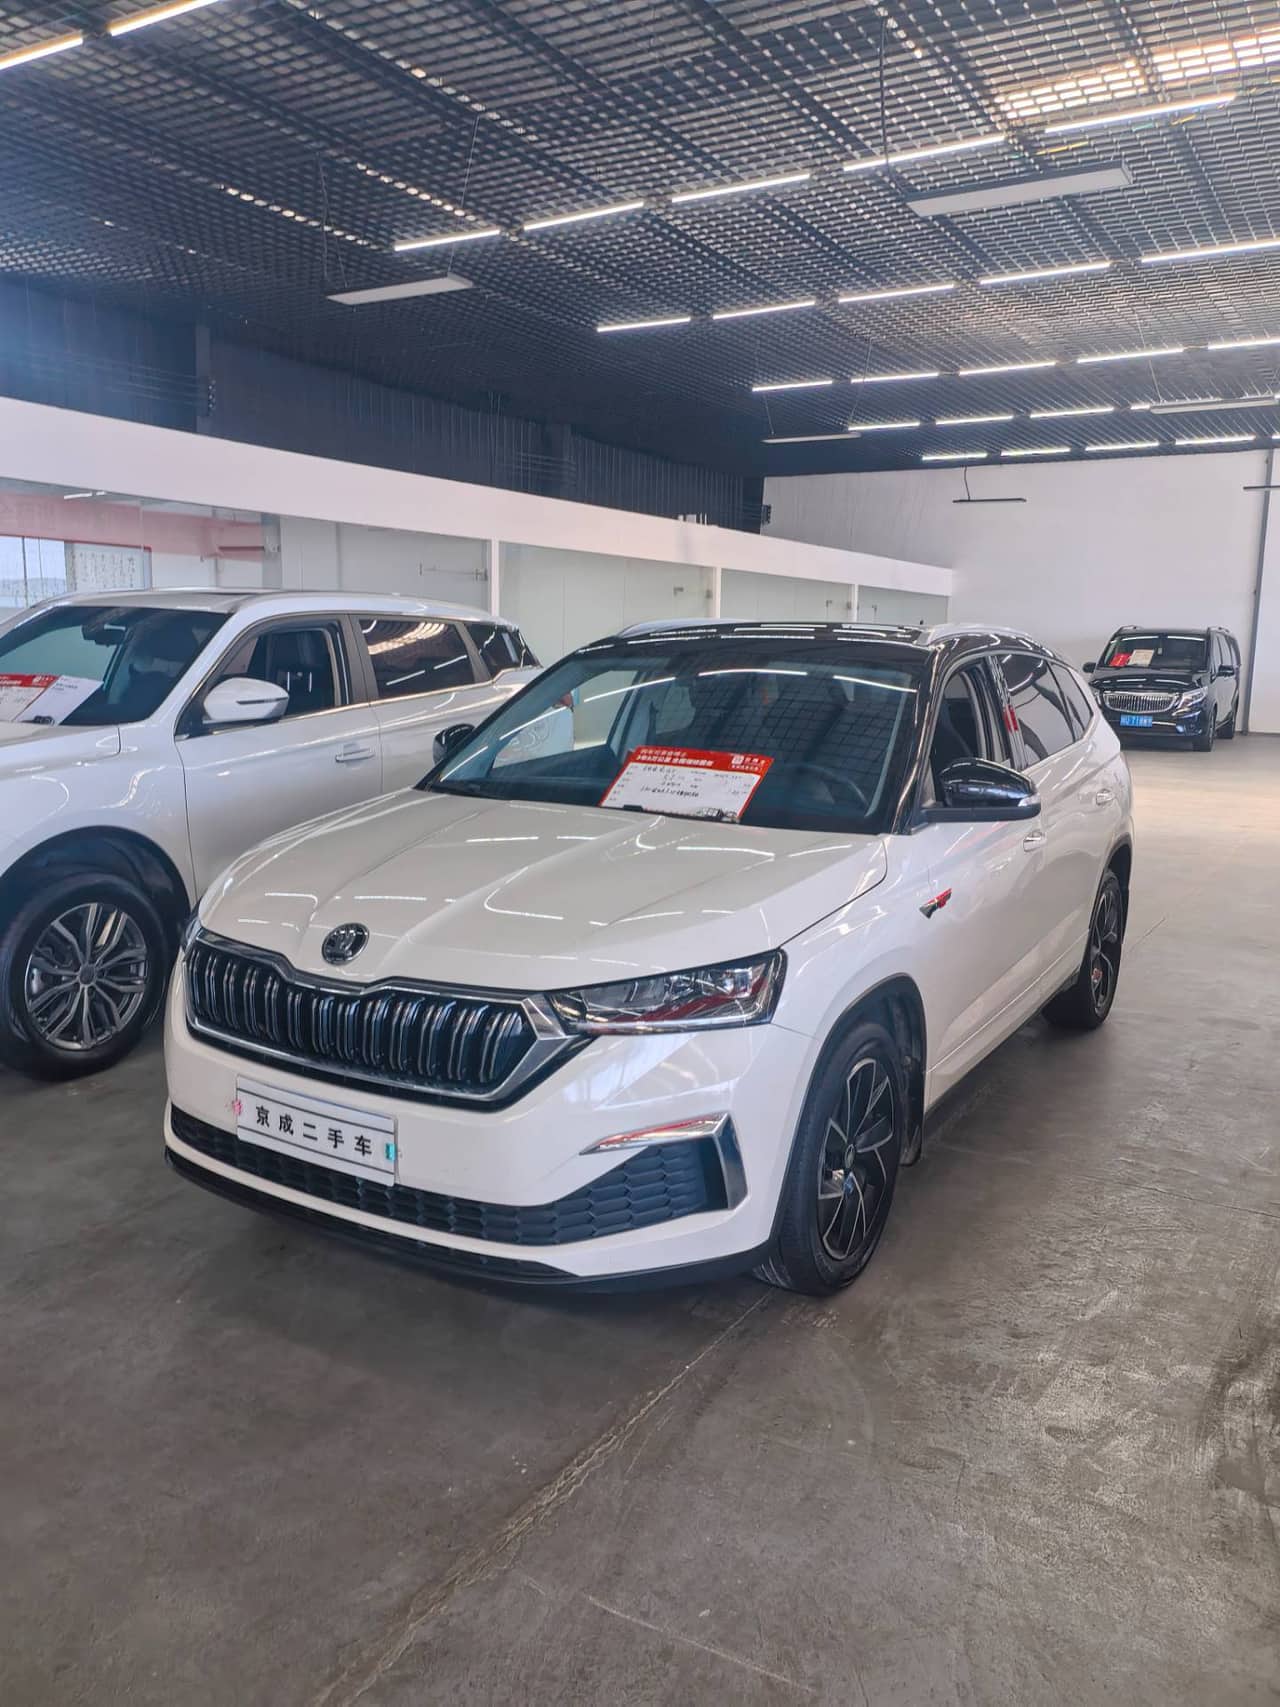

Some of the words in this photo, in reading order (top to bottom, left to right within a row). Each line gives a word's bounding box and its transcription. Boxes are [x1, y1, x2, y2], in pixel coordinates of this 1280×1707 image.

[255, 1105, 372, 1157] 京成二手车
